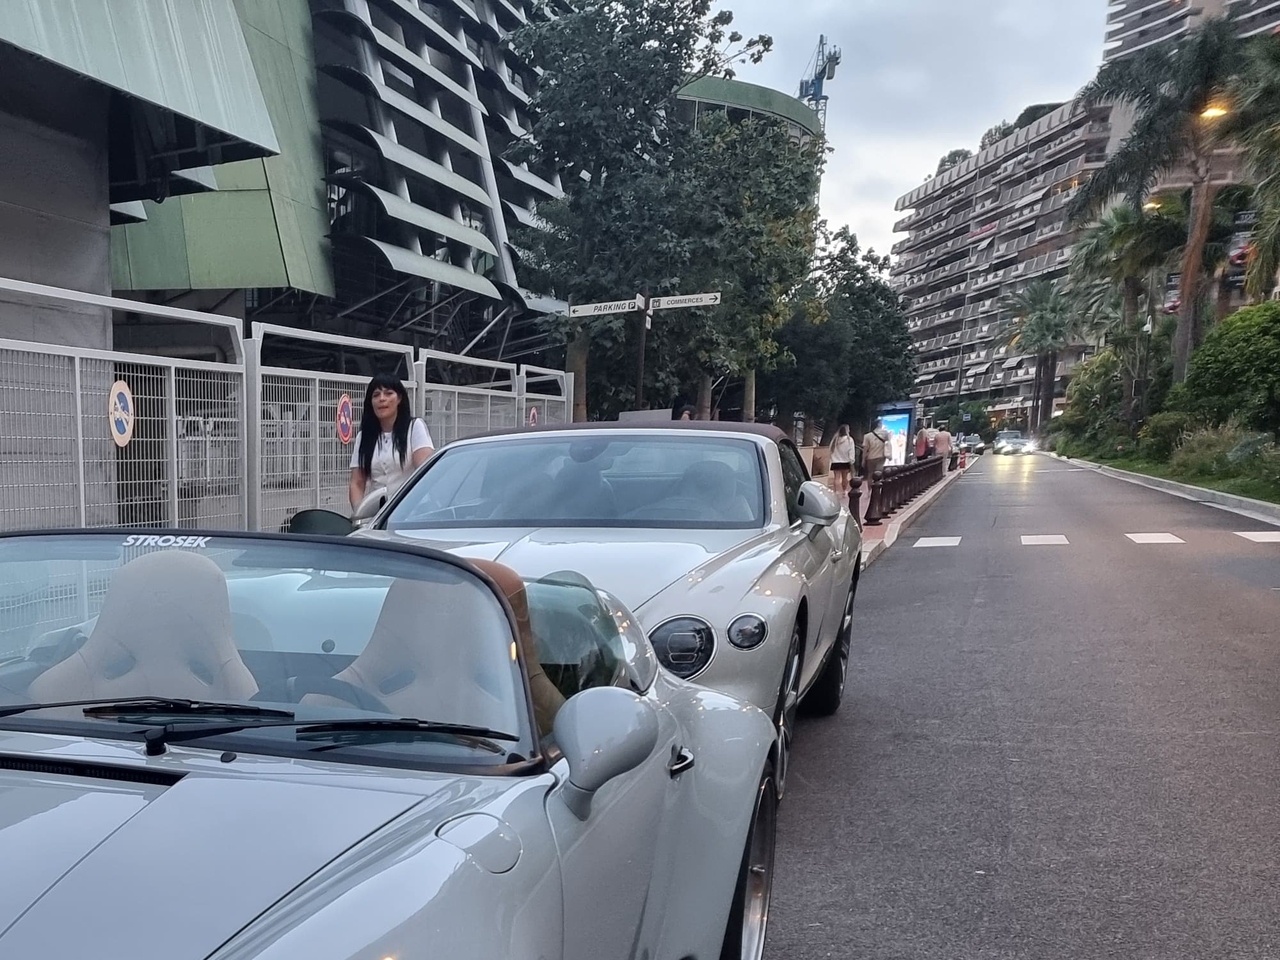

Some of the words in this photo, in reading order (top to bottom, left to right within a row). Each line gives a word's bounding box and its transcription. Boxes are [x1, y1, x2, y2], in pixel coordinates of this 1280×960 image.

[666, 297, 704, 305] COMMERCES
[593, 303, 627, 312] PARKING
[122, 535, 212, 548] STROSEK
